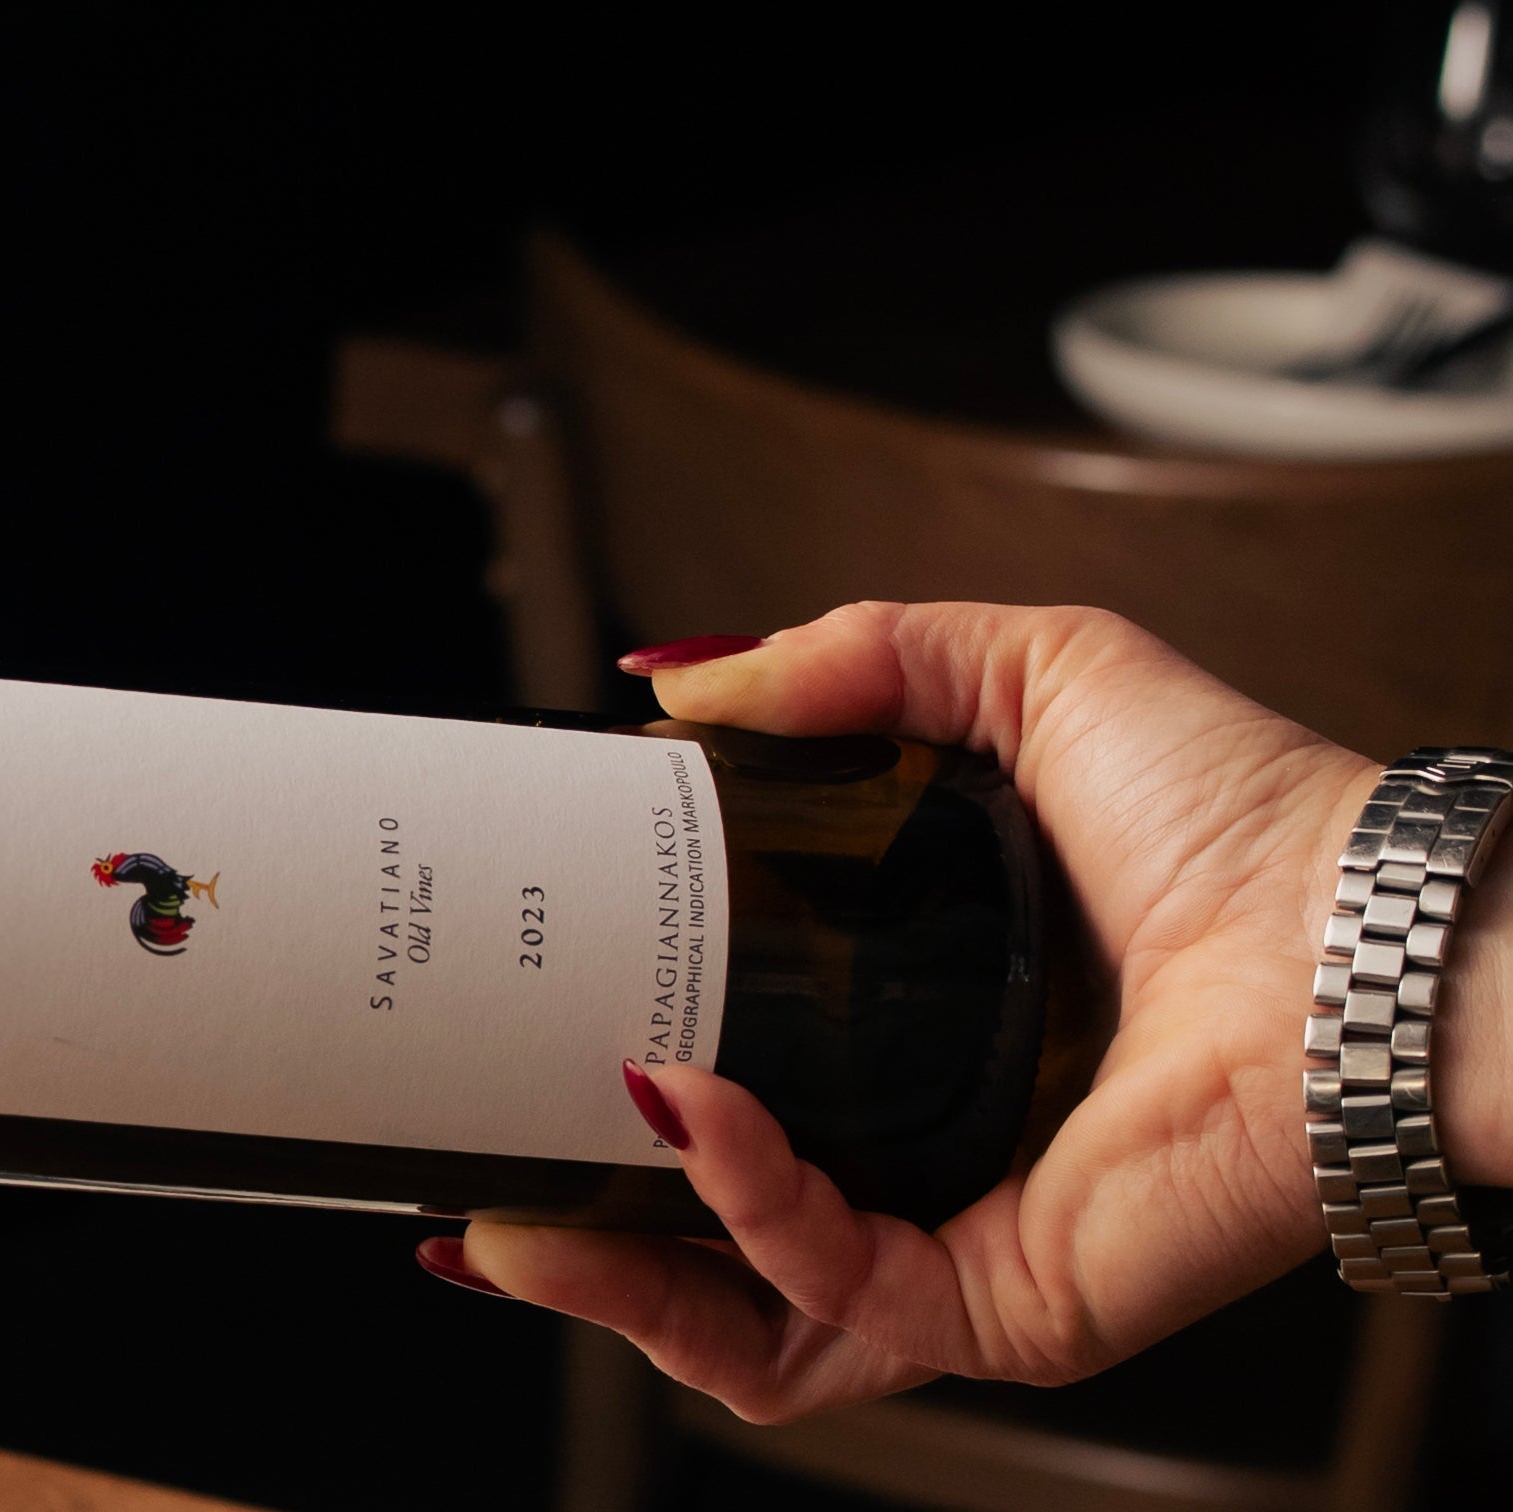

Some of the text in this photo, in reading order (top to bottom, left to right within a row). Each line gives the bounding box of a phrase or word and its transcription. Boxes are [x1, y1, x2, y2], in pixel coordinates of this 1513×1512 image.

[370, 818, 401, 1011] SAVATIANO
[407, 863, 433, 964] Old Vines
[519, 886, 545, 970] 2023
[645, 806, 679, 1066] PAPAGIANNAKOS
[667, 751, 705, 1063] GEOGRAPHICAL INDICATION MARKOPOULO
